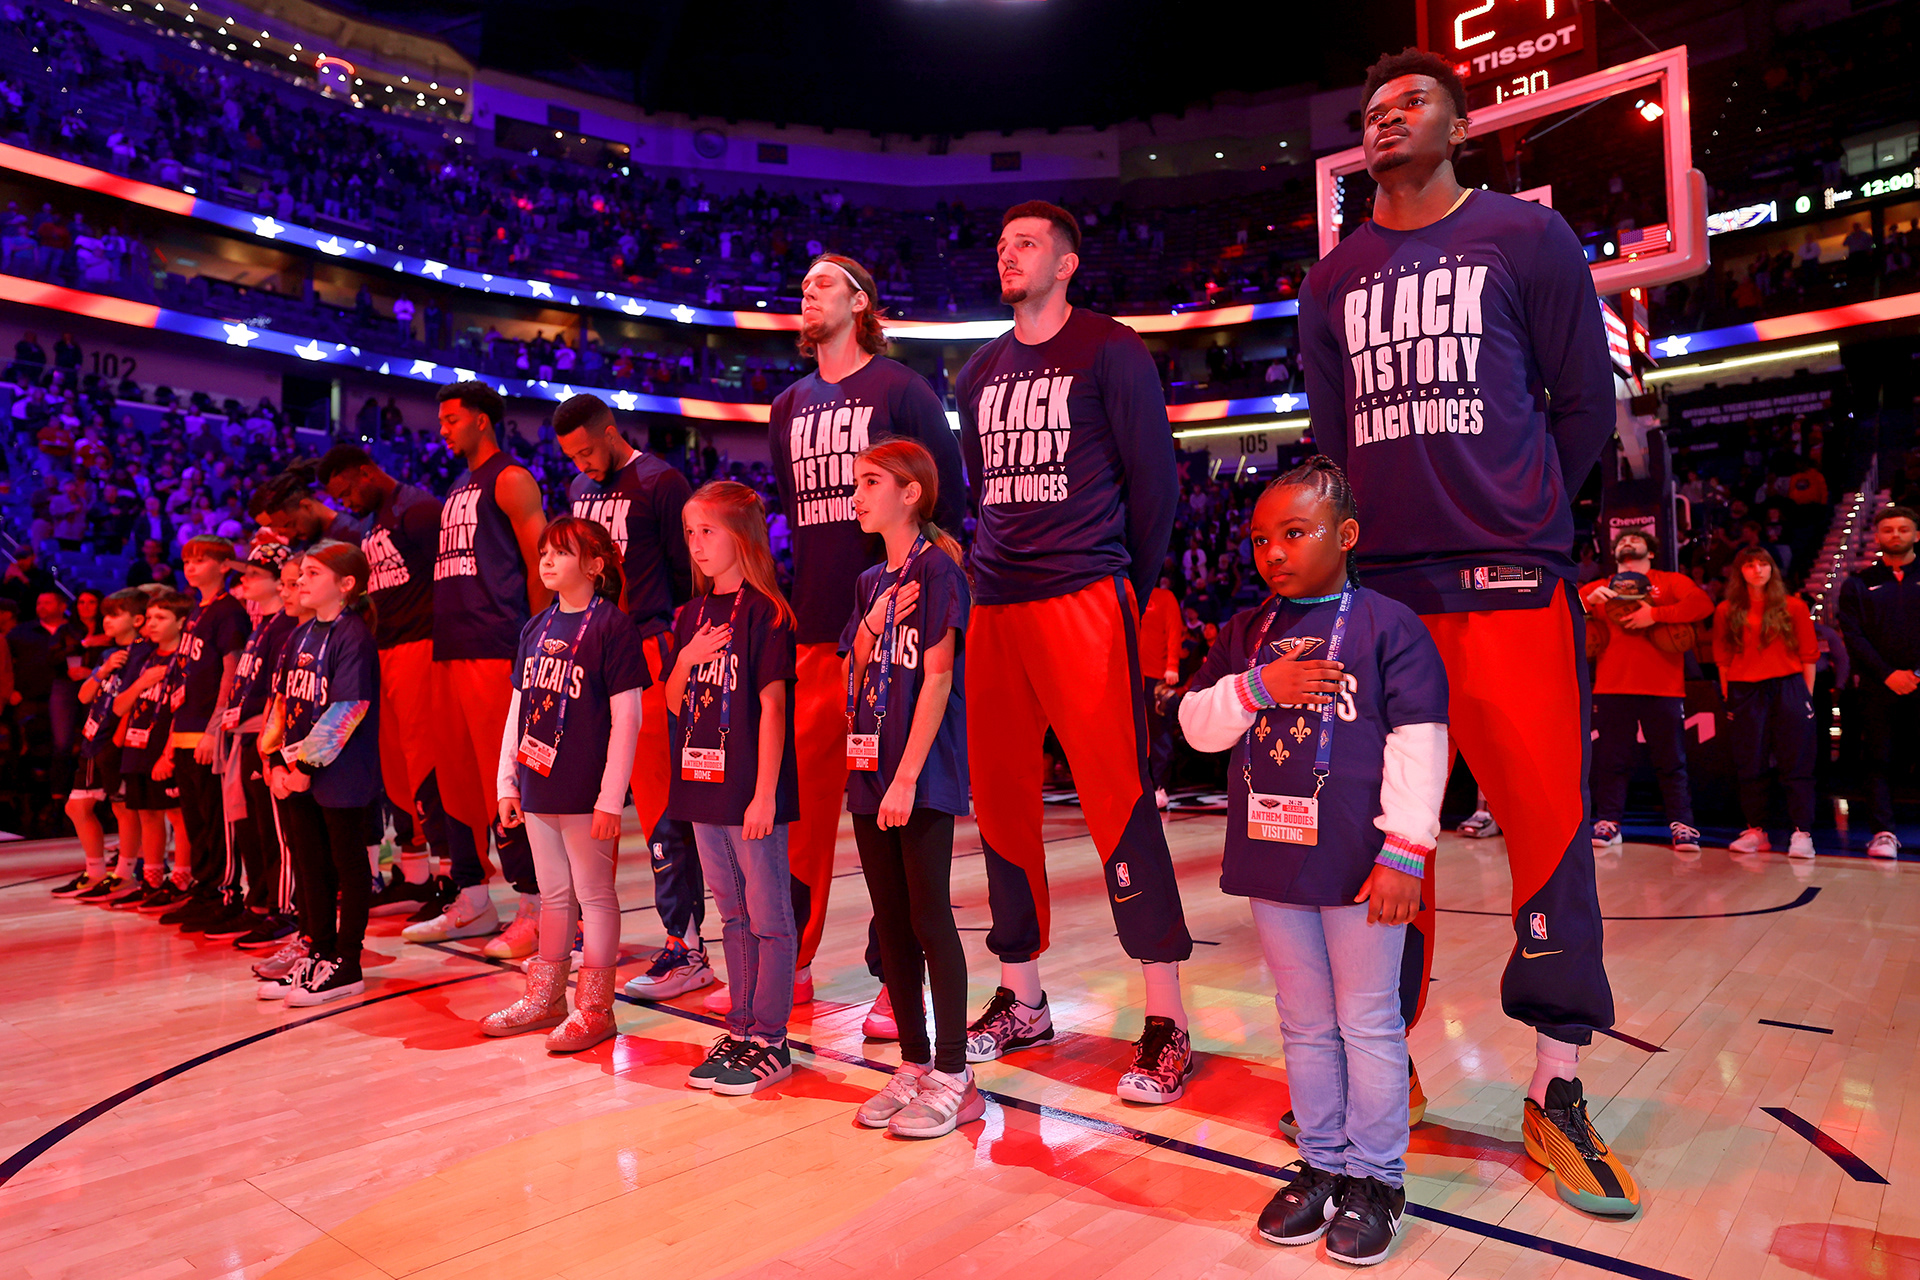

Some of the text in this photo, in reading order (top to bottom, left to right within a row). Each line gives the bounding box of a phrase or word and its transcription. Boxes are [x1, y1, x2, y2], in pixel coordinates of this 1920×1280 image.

[1454, 0, 1555, 50] 2
[1473, 24, 1576, 73] TISSOT
[1860, 172, 1914, 197] 12:00
[1360, 254, 1464, 284] BUILT BY
[1344, 266, 1488, 355] BLACK
[92, 351, 136, 381] 102
[994, 367, 1060, 382] BUILT BY
[802, 401, 835, 413] BUILT
[978, 376, 1074, 435] BLACK
[1458, 388, 1480, 396] BY
[790, 406, 873, 462] BLACK
[1355, 398, 1484, 447] BLACK VOICES
[1239, 433, 1268, 455] 105
[792, 453, 857, 493] ISTOR
[797, 489, 843, 501] LEVATED
[983, 474, 1068, 506] ACK VOICES
[797, 496, 857, 526] LACK VOIC
[1608, 515, 1656, 528] Chevron
[694, 770, 711, 780] HOME
[1251, 811, 1314, 826] ANTHEM BUDDIES
[1261, 825, 1303, 841] VISITING
